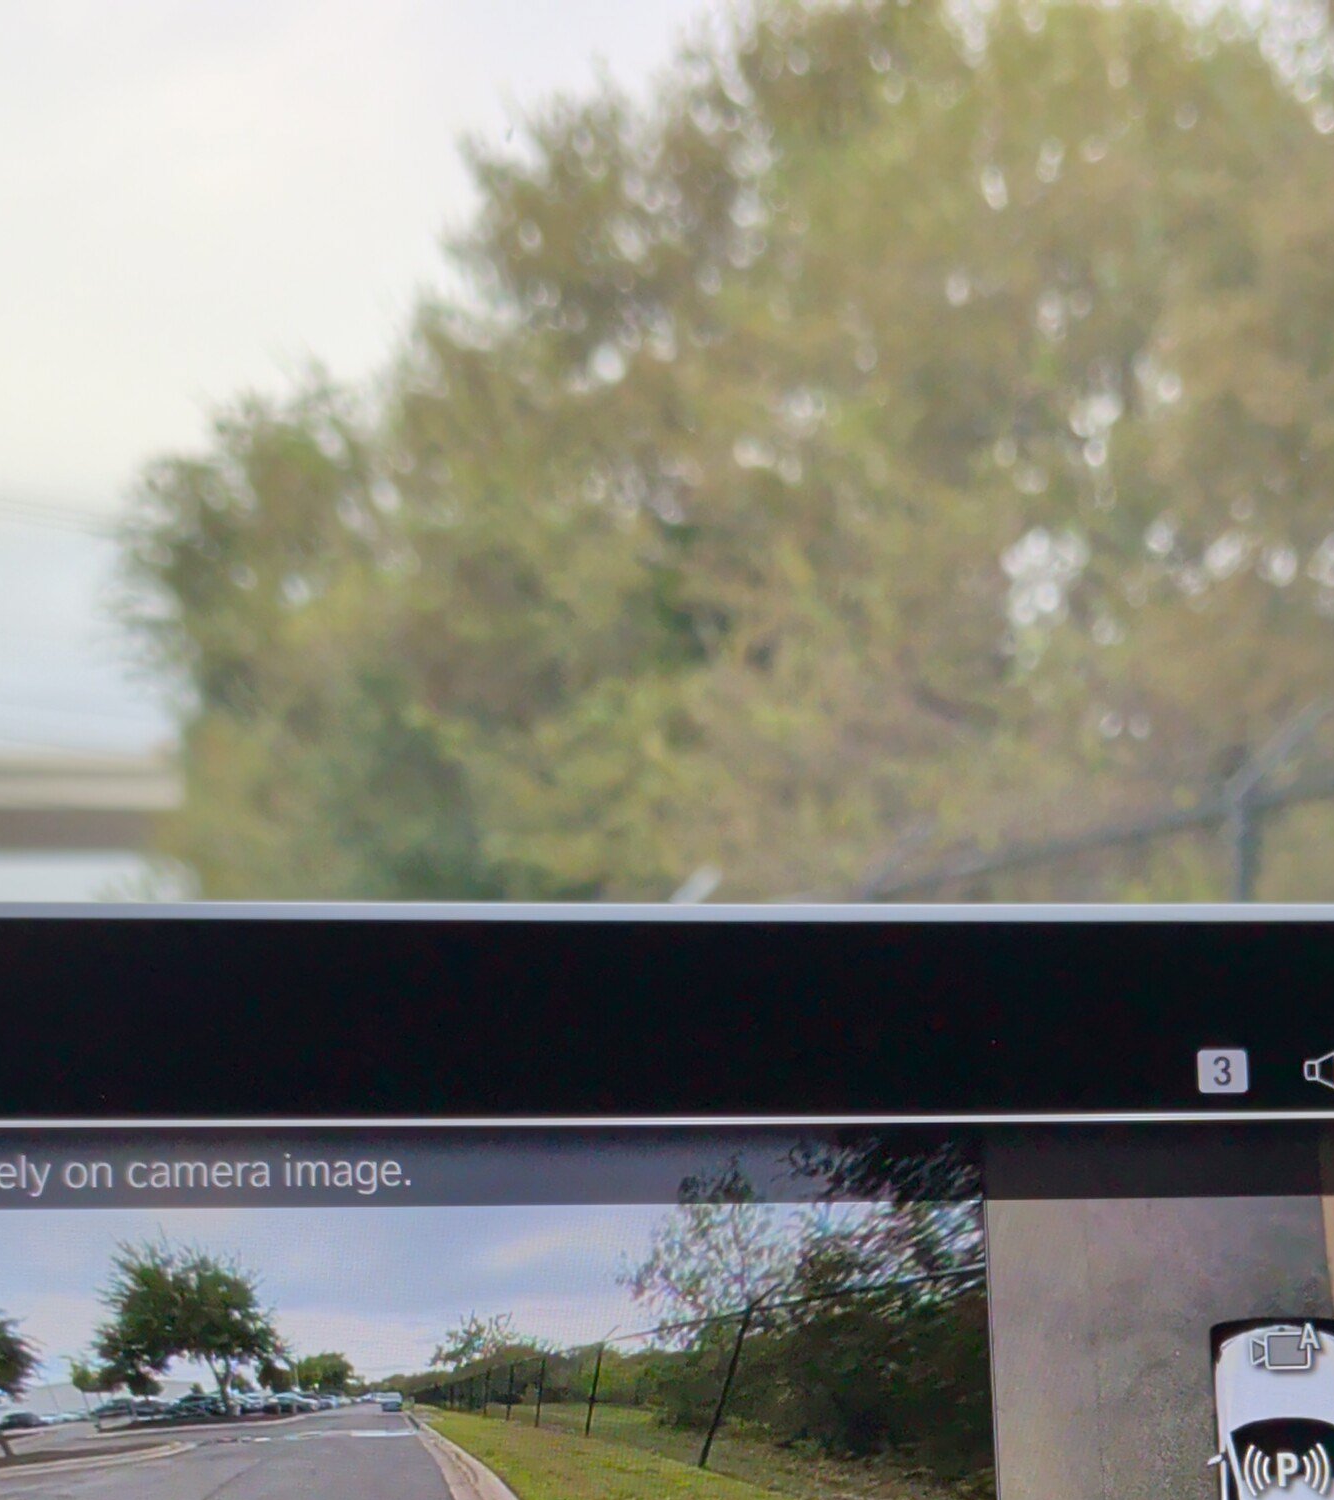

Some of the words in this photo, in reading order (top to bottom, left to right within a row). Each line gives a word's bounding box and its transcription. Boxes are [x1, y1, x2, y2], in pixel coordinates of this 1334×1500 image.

[1213, 1056, 1233, 1087] 3
[62, 1160, 113, 1190] on
[125, 1159, 271, 1189] camera
[283, 1152, 412, 1196] image.
[1276, 1450, 1302, 1487] P
